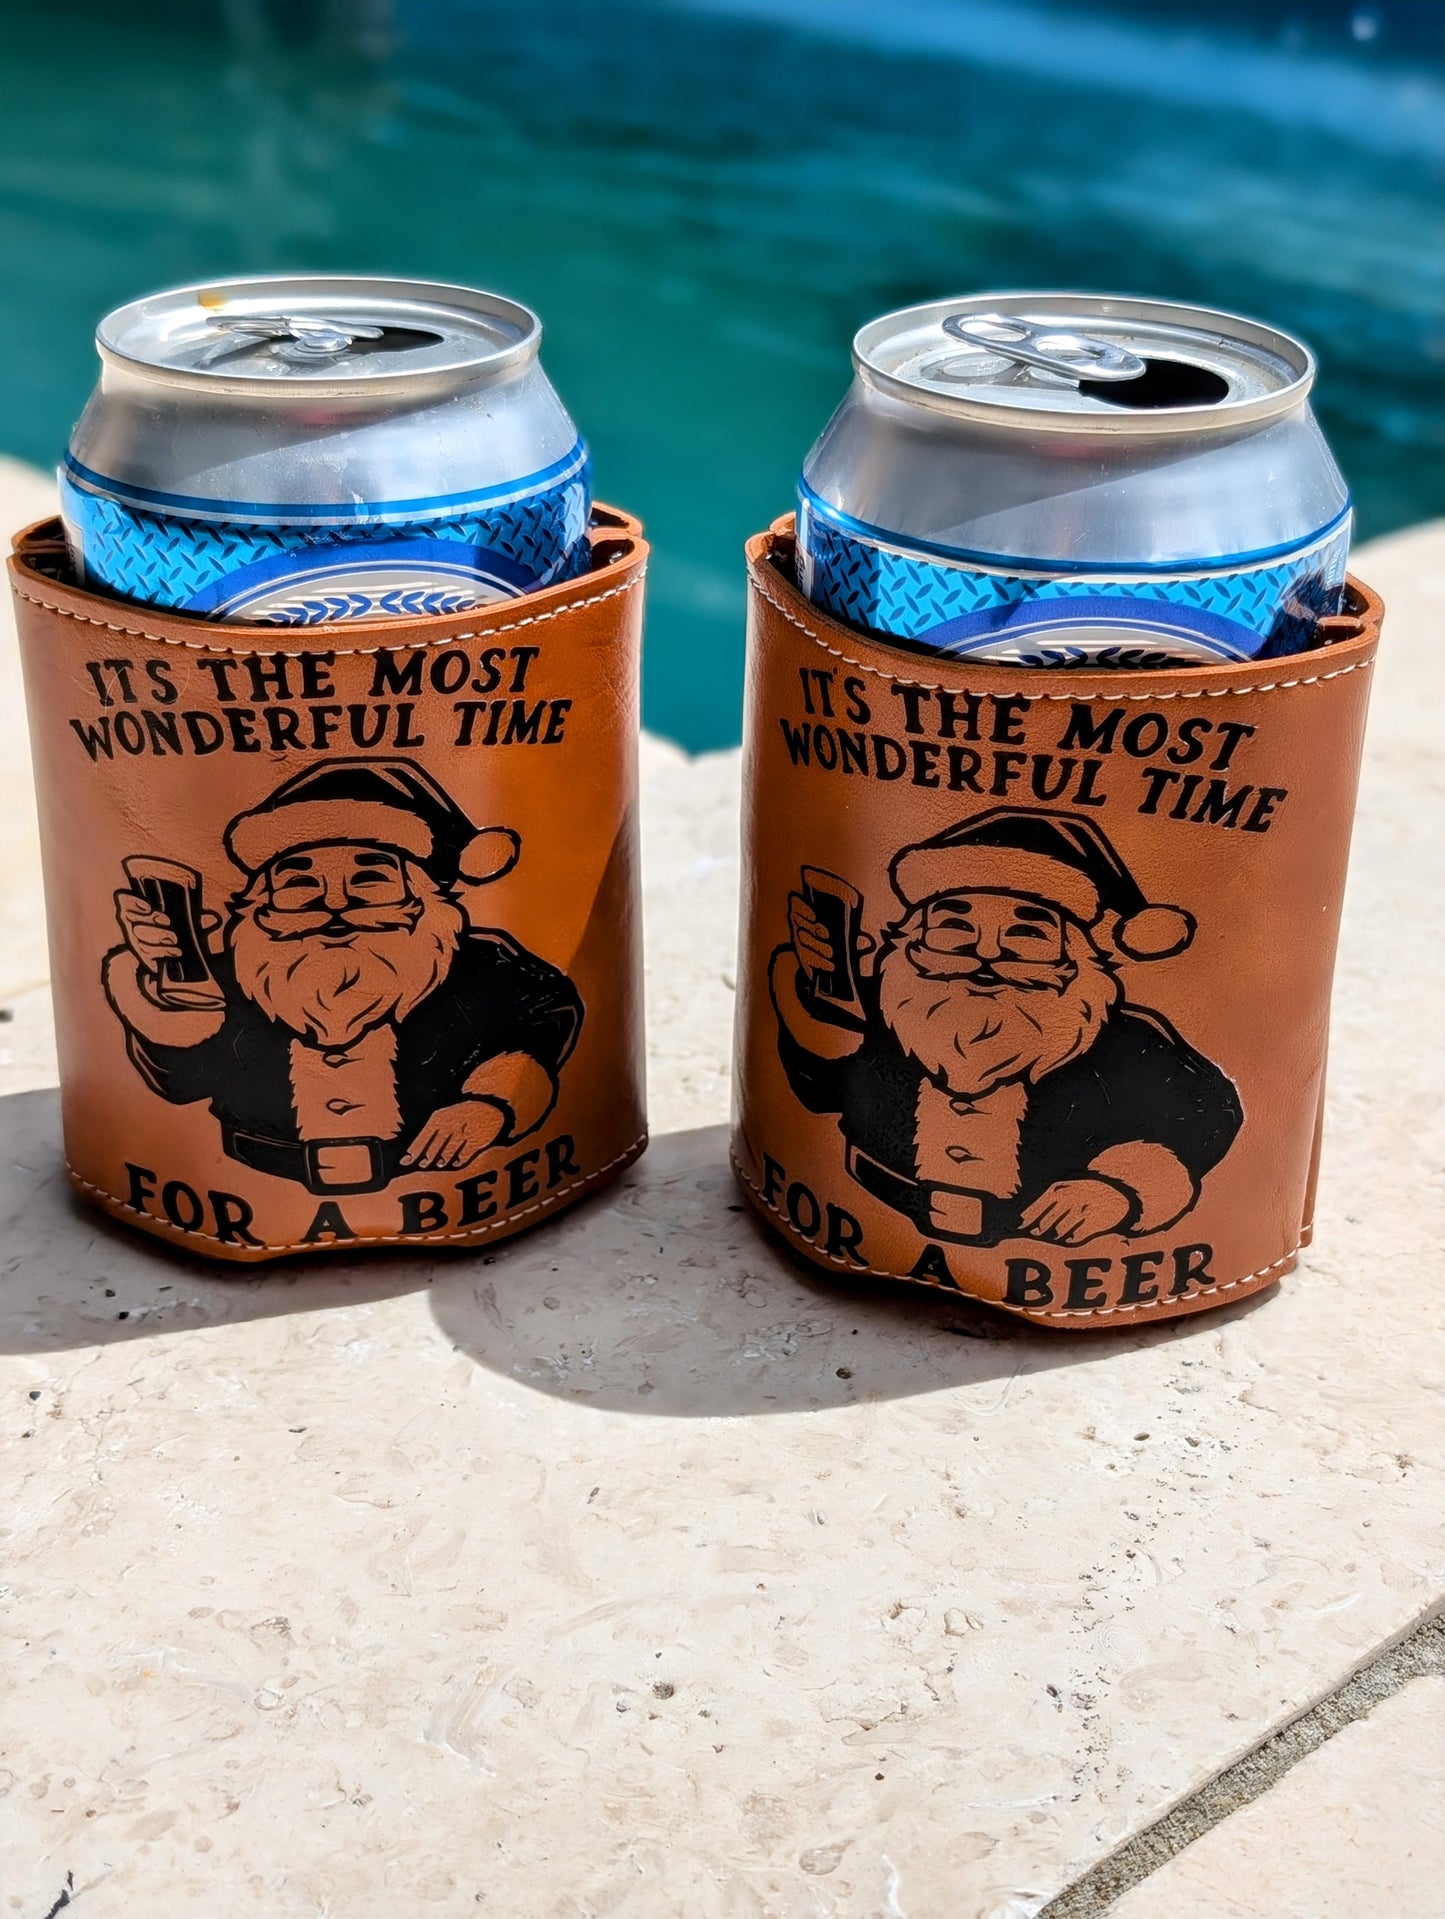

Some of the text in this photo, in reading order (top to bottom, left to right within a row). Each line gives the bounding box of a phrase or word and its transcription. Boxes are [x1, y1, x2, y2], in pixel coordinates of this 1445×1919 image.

[197, 653, 336, 703] THE
[367, 646, 541, 699] MOST
[798, 666, 1258, 773] IT'S THE MOST
[69, 699, 572, 762] WONDERFUL TIME
[778, 717, 1289, 834] WONDERFUL TIME
[124, 1134, 581, 1247] FOR A BEER
[762, 1153, 1217, 1310] FOR A BEER
